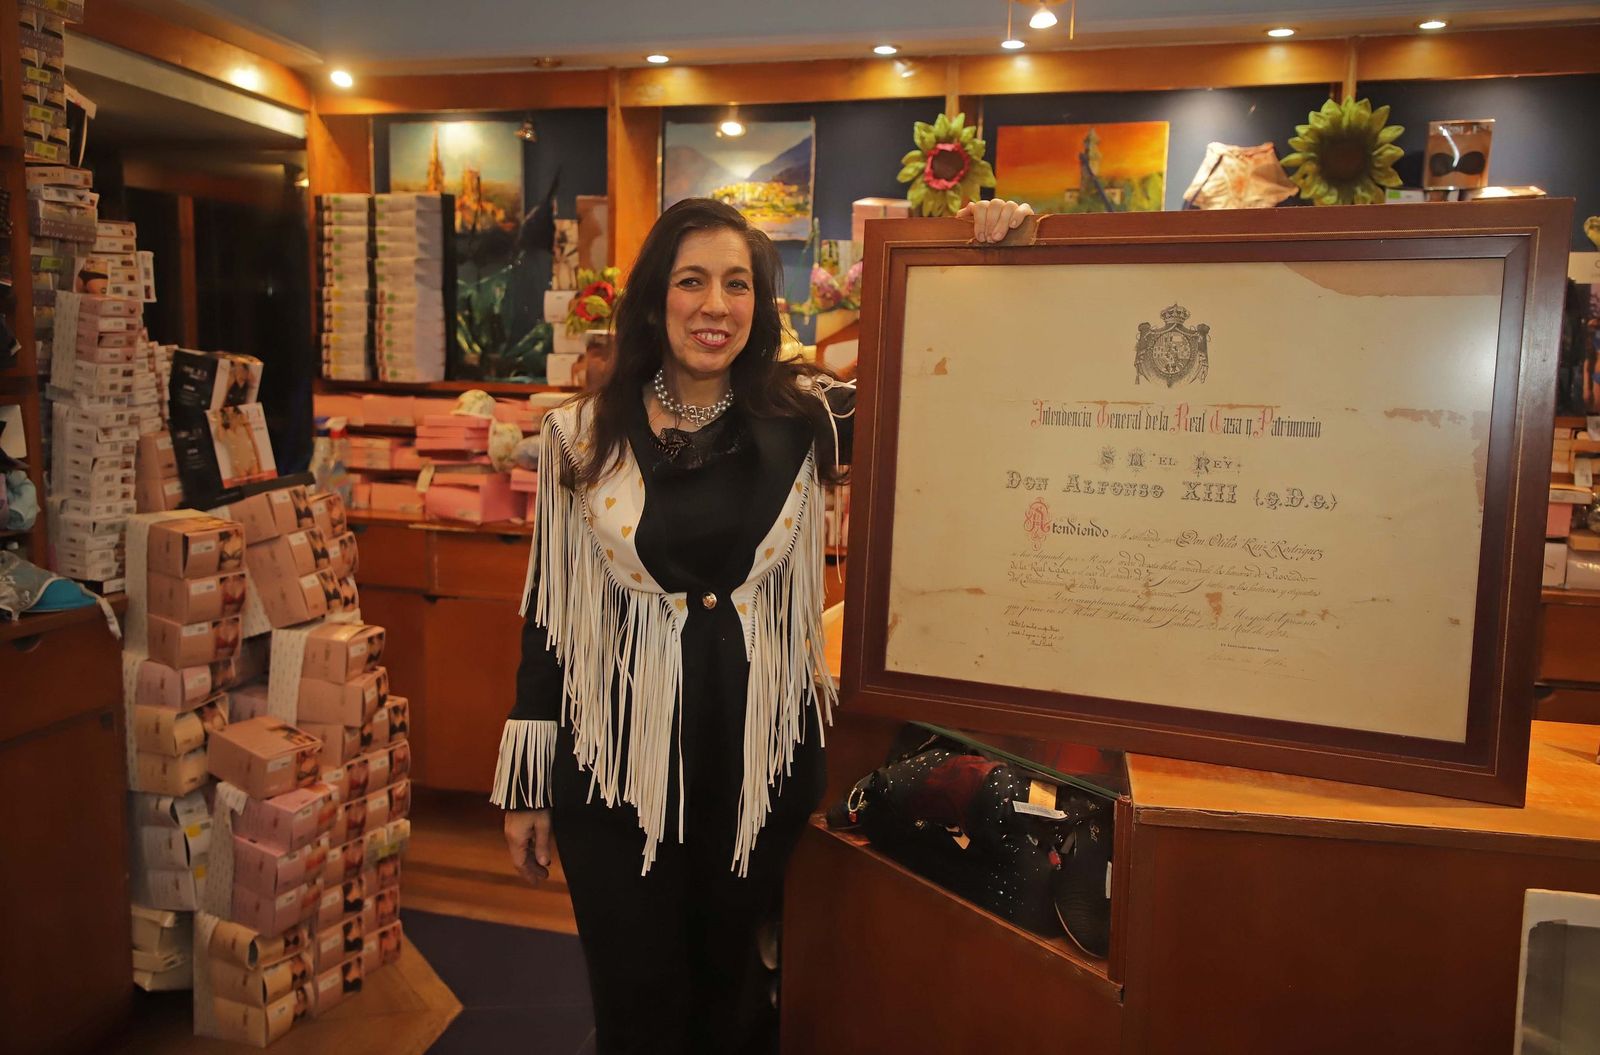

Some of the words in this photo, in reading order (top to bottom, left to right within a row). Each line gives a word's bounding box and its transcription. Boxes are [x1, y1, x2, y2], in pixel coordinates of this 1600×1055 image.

[1031, 398, 1092, 428] Intendencia
[1097, 404, 1142, 431] General
[1169, 402, 1207, 435] Real
[1253, 406, 1321, 438] Patrimonio
[1181, 481, 1238, 503] XIII
[1024, 497, 1109, 551] Atendiendo
[1176, 530, 1205, 548] Don
[1209, 532, 1238, 549] Otilio
[1240, 537, 1277, 559] Ruiz
